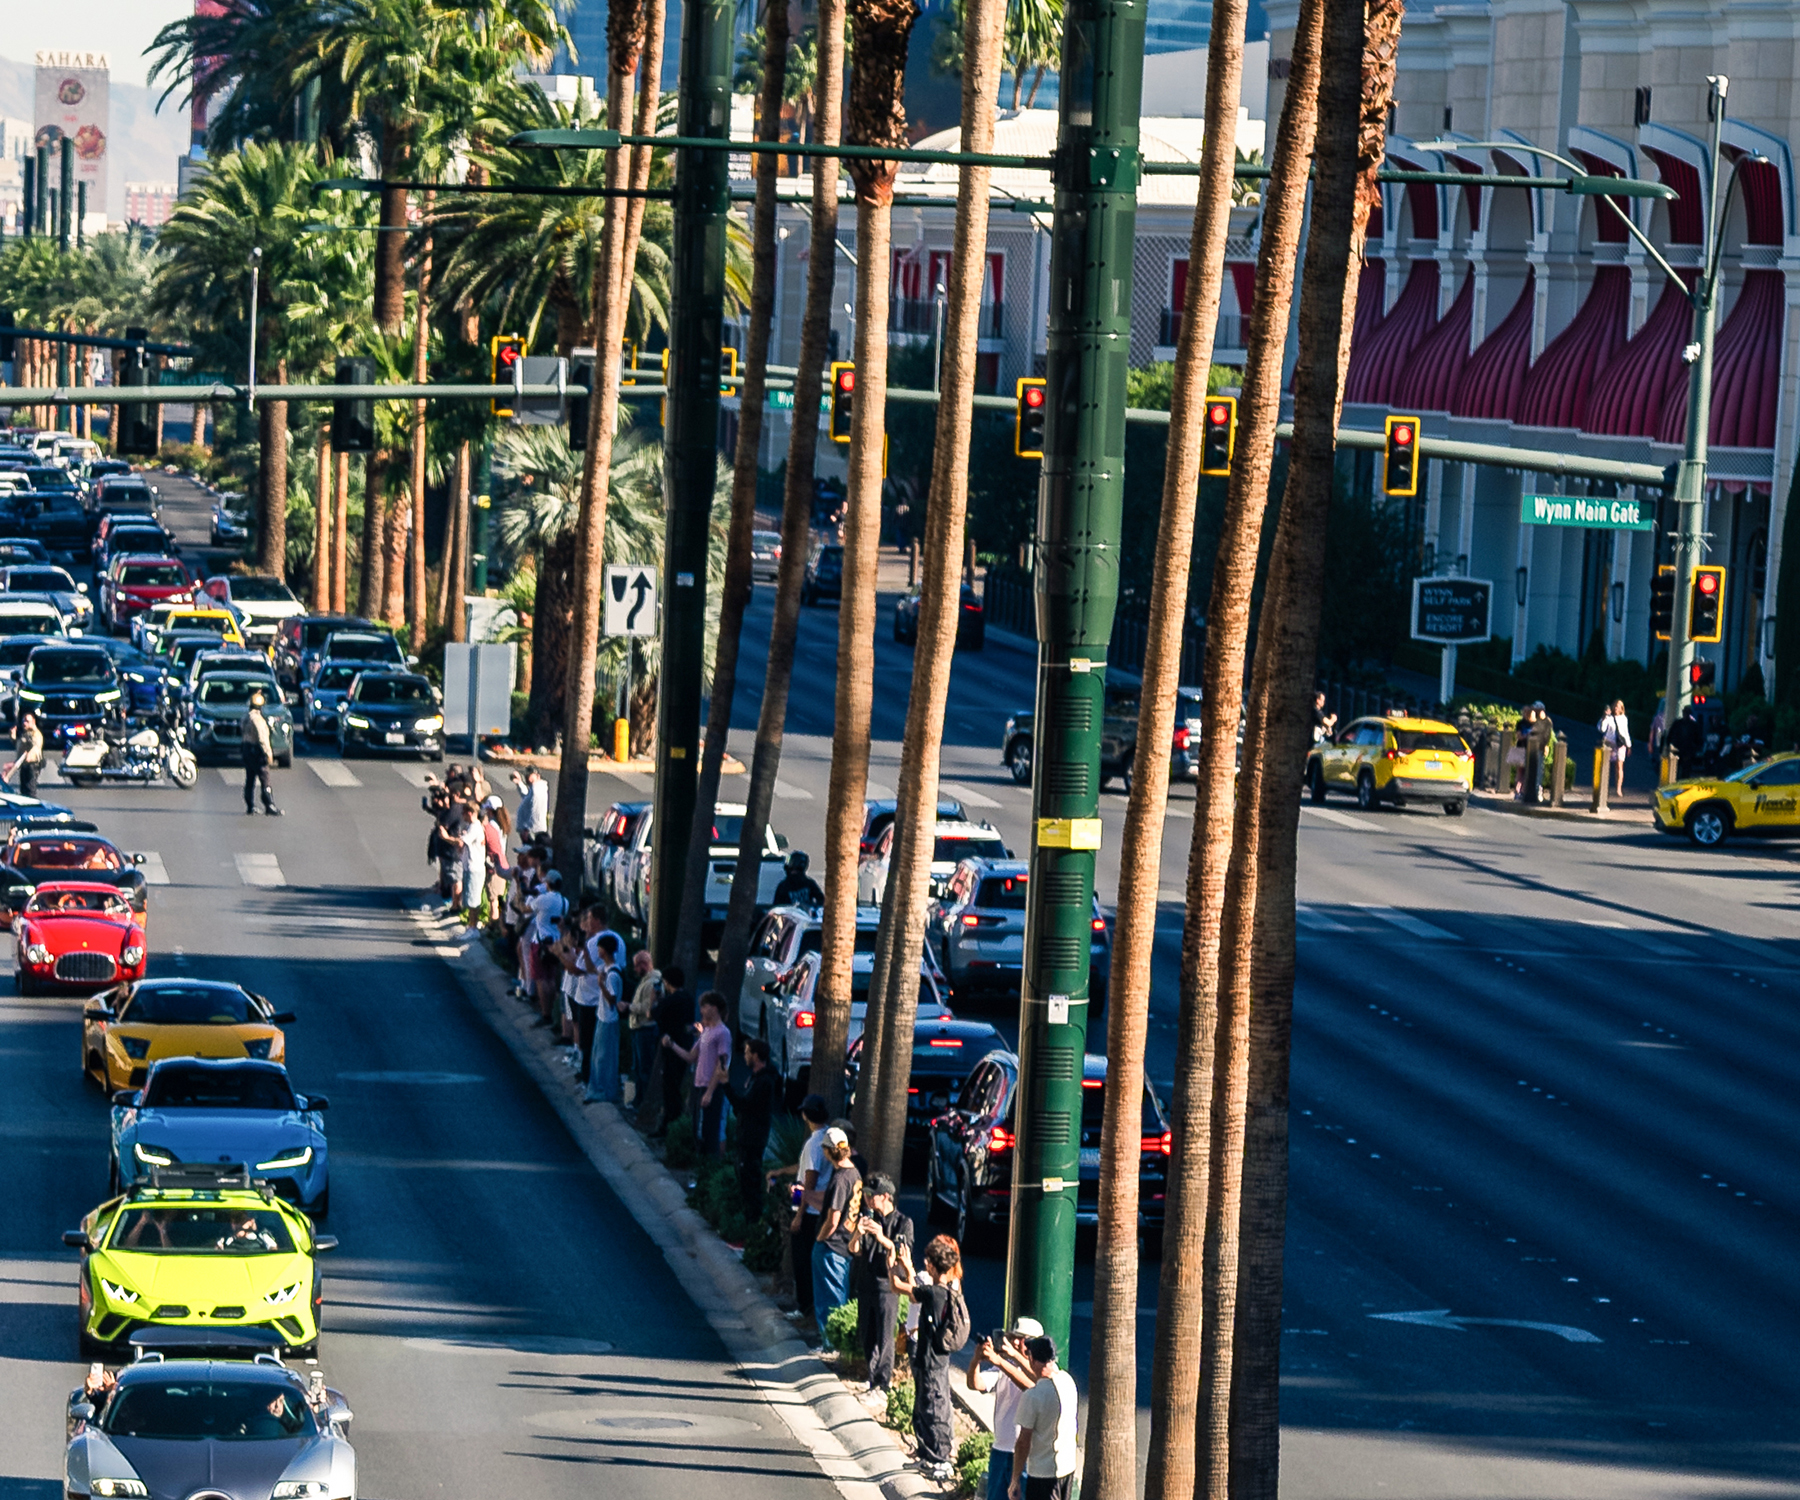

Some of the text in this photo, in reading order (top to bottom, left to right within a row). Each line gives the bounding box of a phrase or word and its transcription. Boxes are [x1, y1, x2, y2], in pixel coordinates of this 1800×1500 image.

[35, 51, 108, 67] SAHARA
[1534, 497, 1640, 525] Wynn Main Gate
